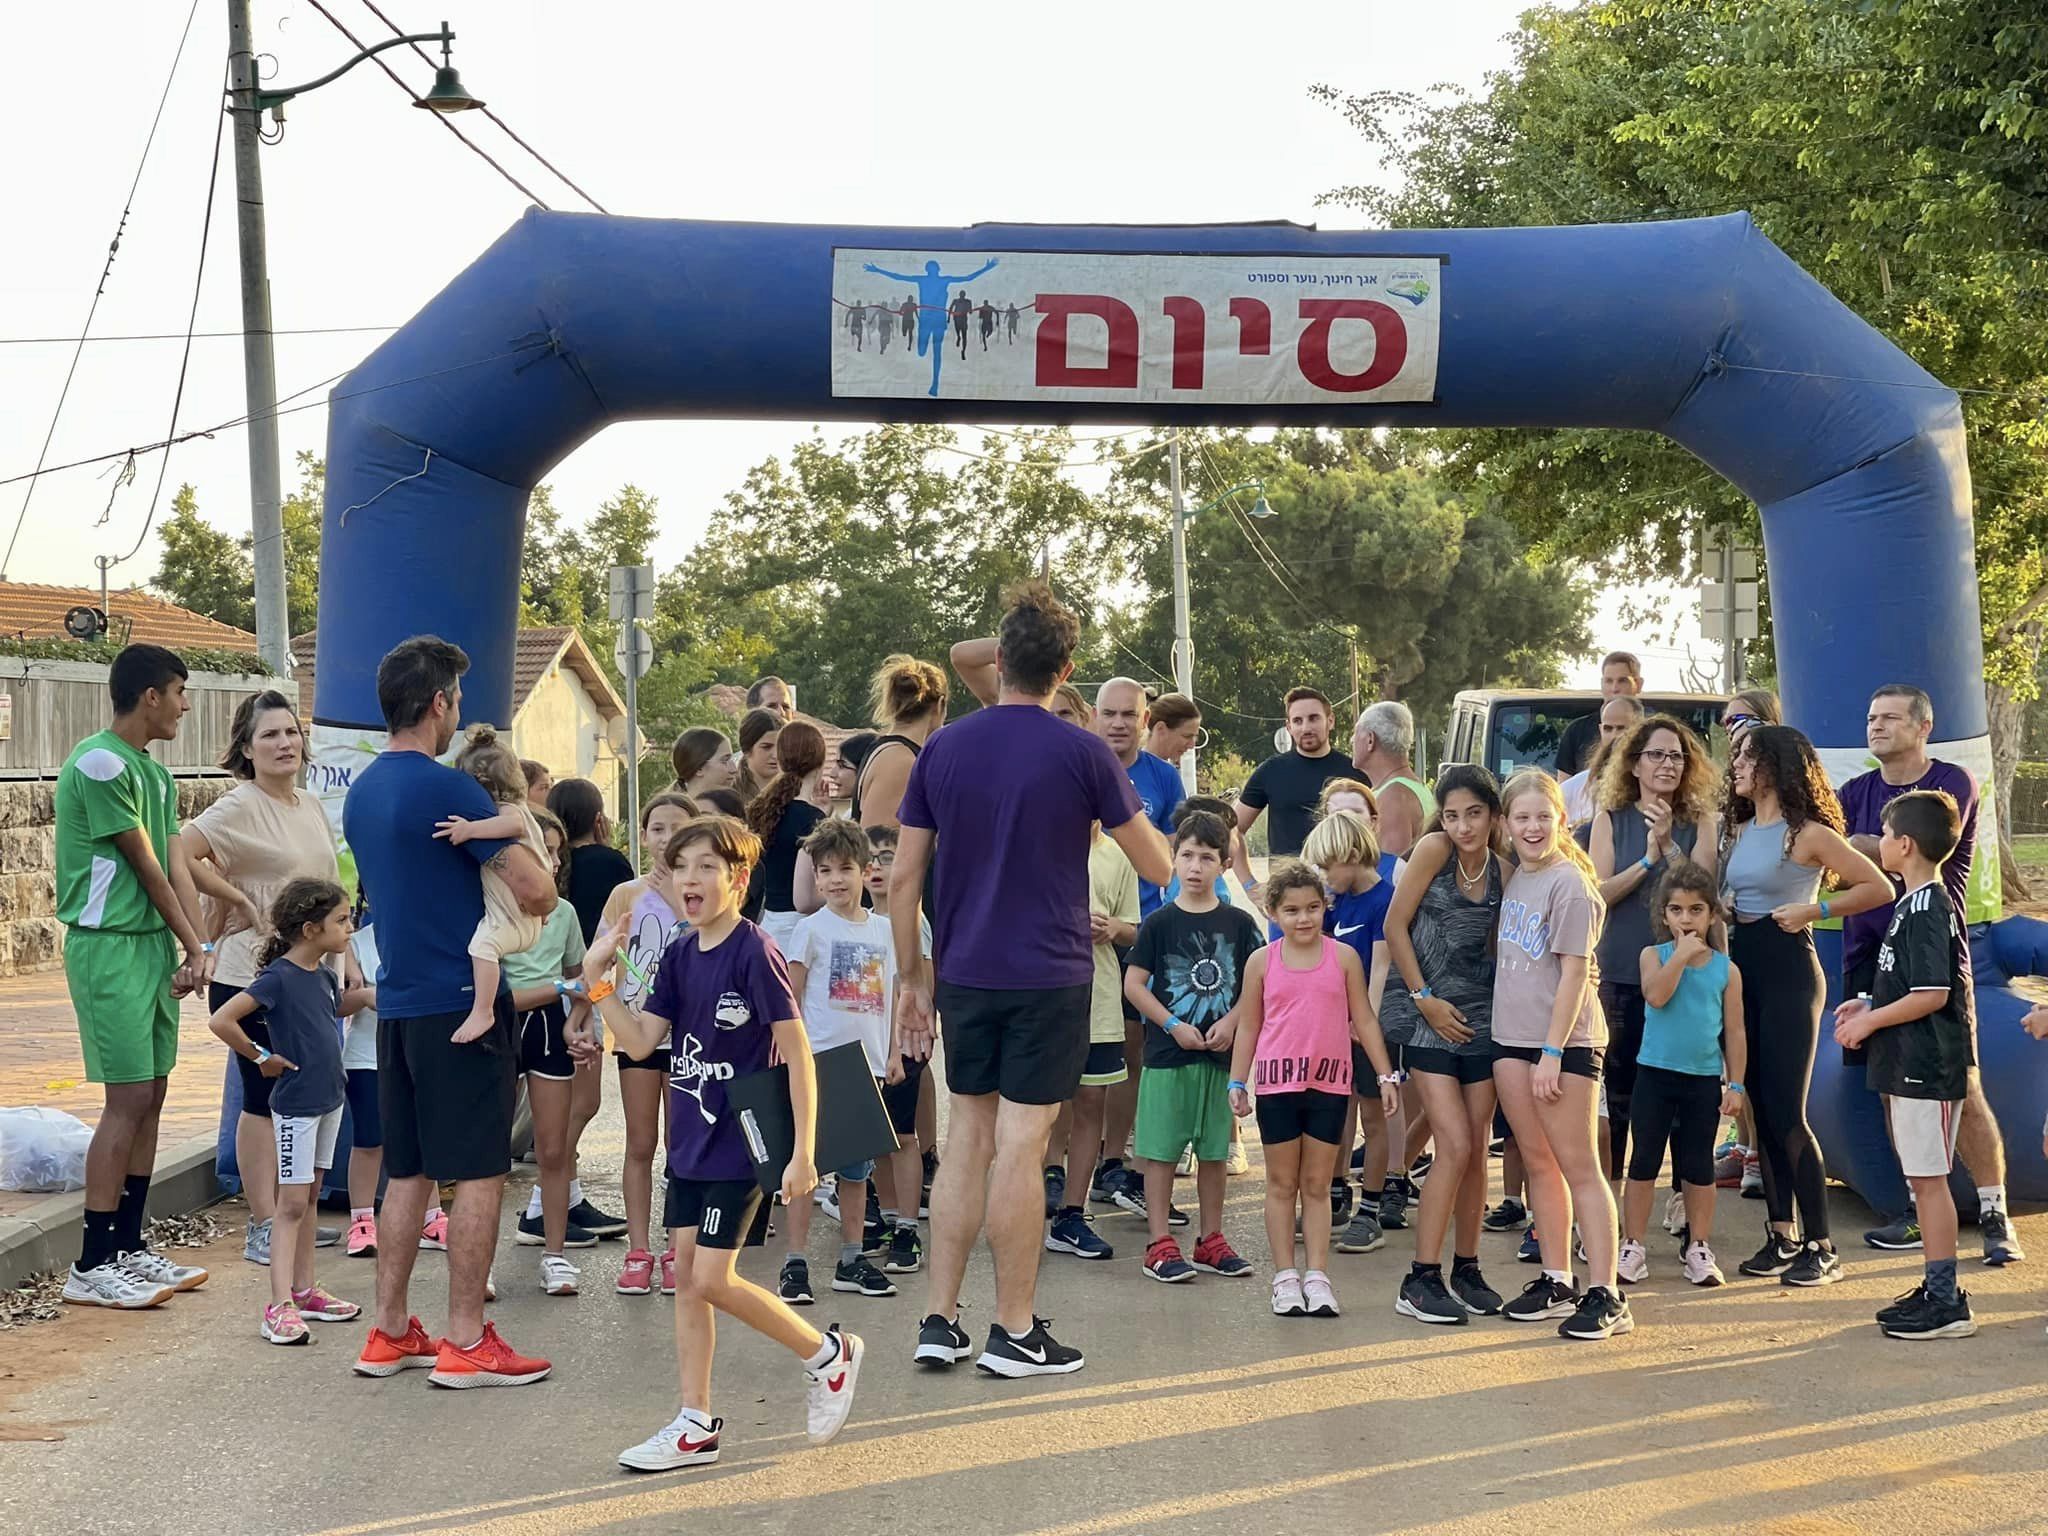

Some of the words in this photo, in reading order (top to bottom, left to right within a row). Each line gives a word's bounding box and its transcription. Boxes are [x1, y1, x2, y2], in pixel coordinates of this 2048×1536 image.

[1248, 273, 1289, 283] וספורט
[1292, 274, 1317, 284] נוער
[1320, 274, 1353, 287] חינוך,
[1034, 294, 1408, 392] סיום
[1257, 1056, 1309, 1085] WORK
[281, 1124, 294, 1178] SWEET
[703, 1206, 721, 1235] 10
